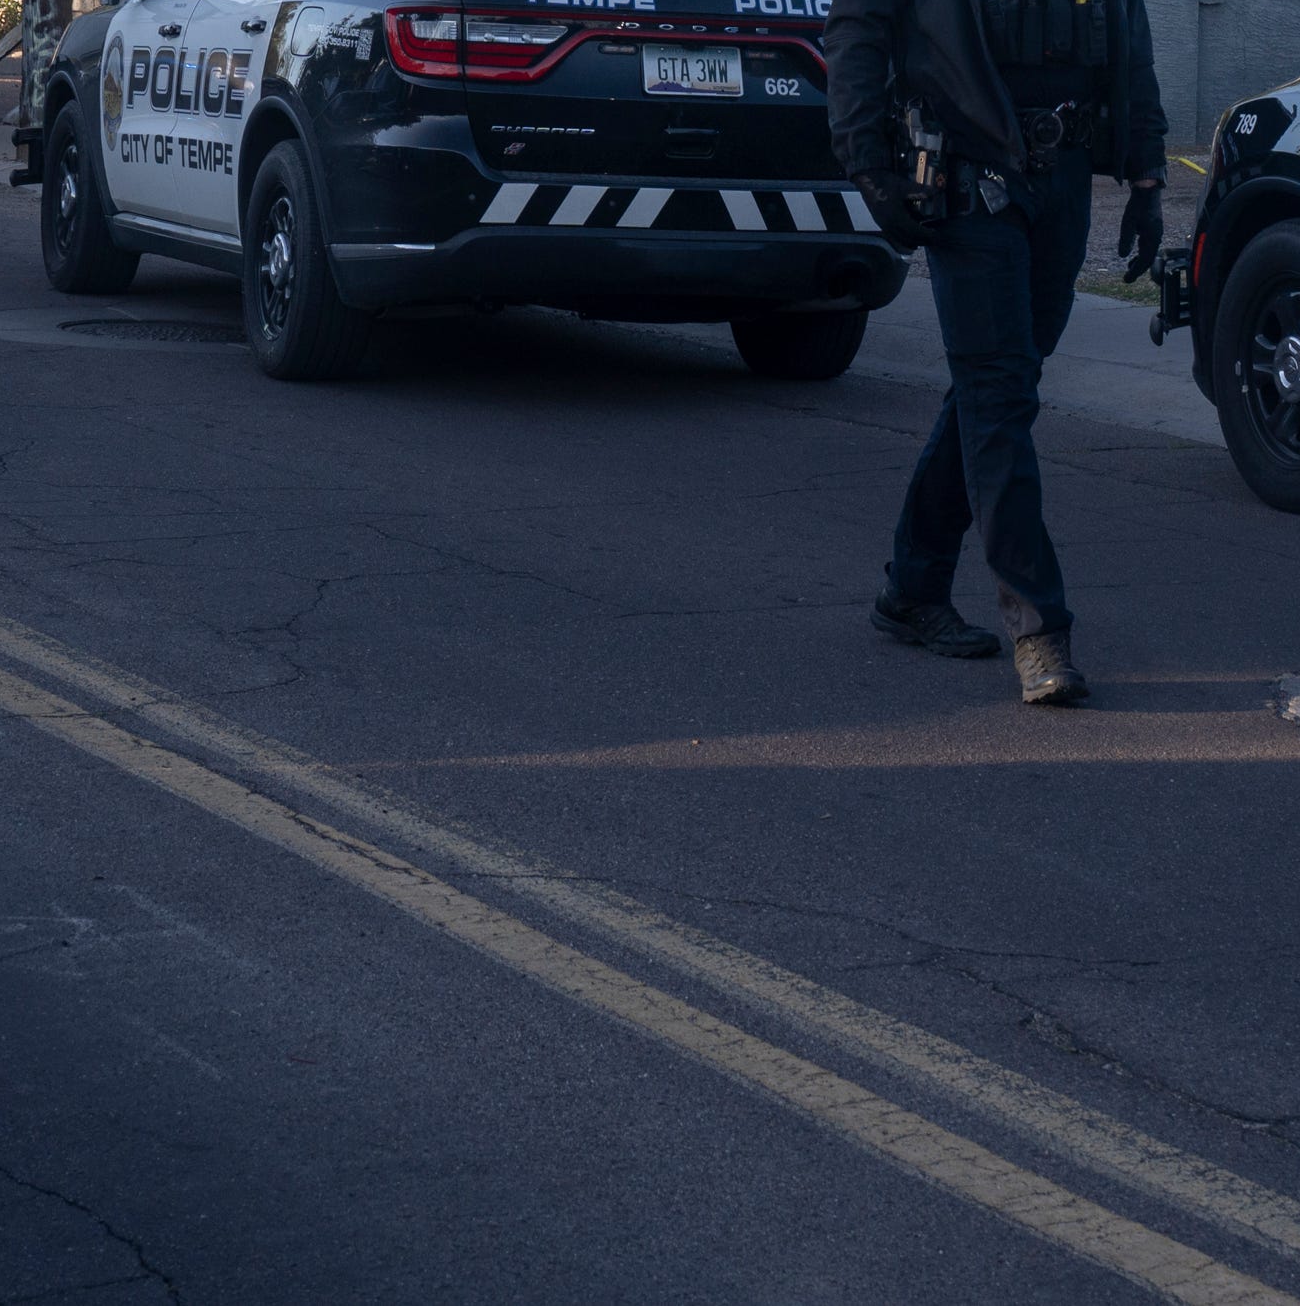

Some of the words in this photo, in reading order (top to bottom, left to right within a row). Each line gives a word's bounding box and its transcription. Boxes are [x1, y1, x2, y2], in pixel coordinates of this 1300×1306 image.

[625, 21, 770, 35] DODGE
[657, 57, 691, 82] GTA
[696, 59, 729, 84] 3WW
[126, 46, 254, 120] POLICE
[764, 78, 801, 96] 662
[1234, 113, 1258, 135] 789
[120, 133, 149, 163] CITY
[154, 134, 173, 165] OF
[178, 137, 233, 175] TEMPE
